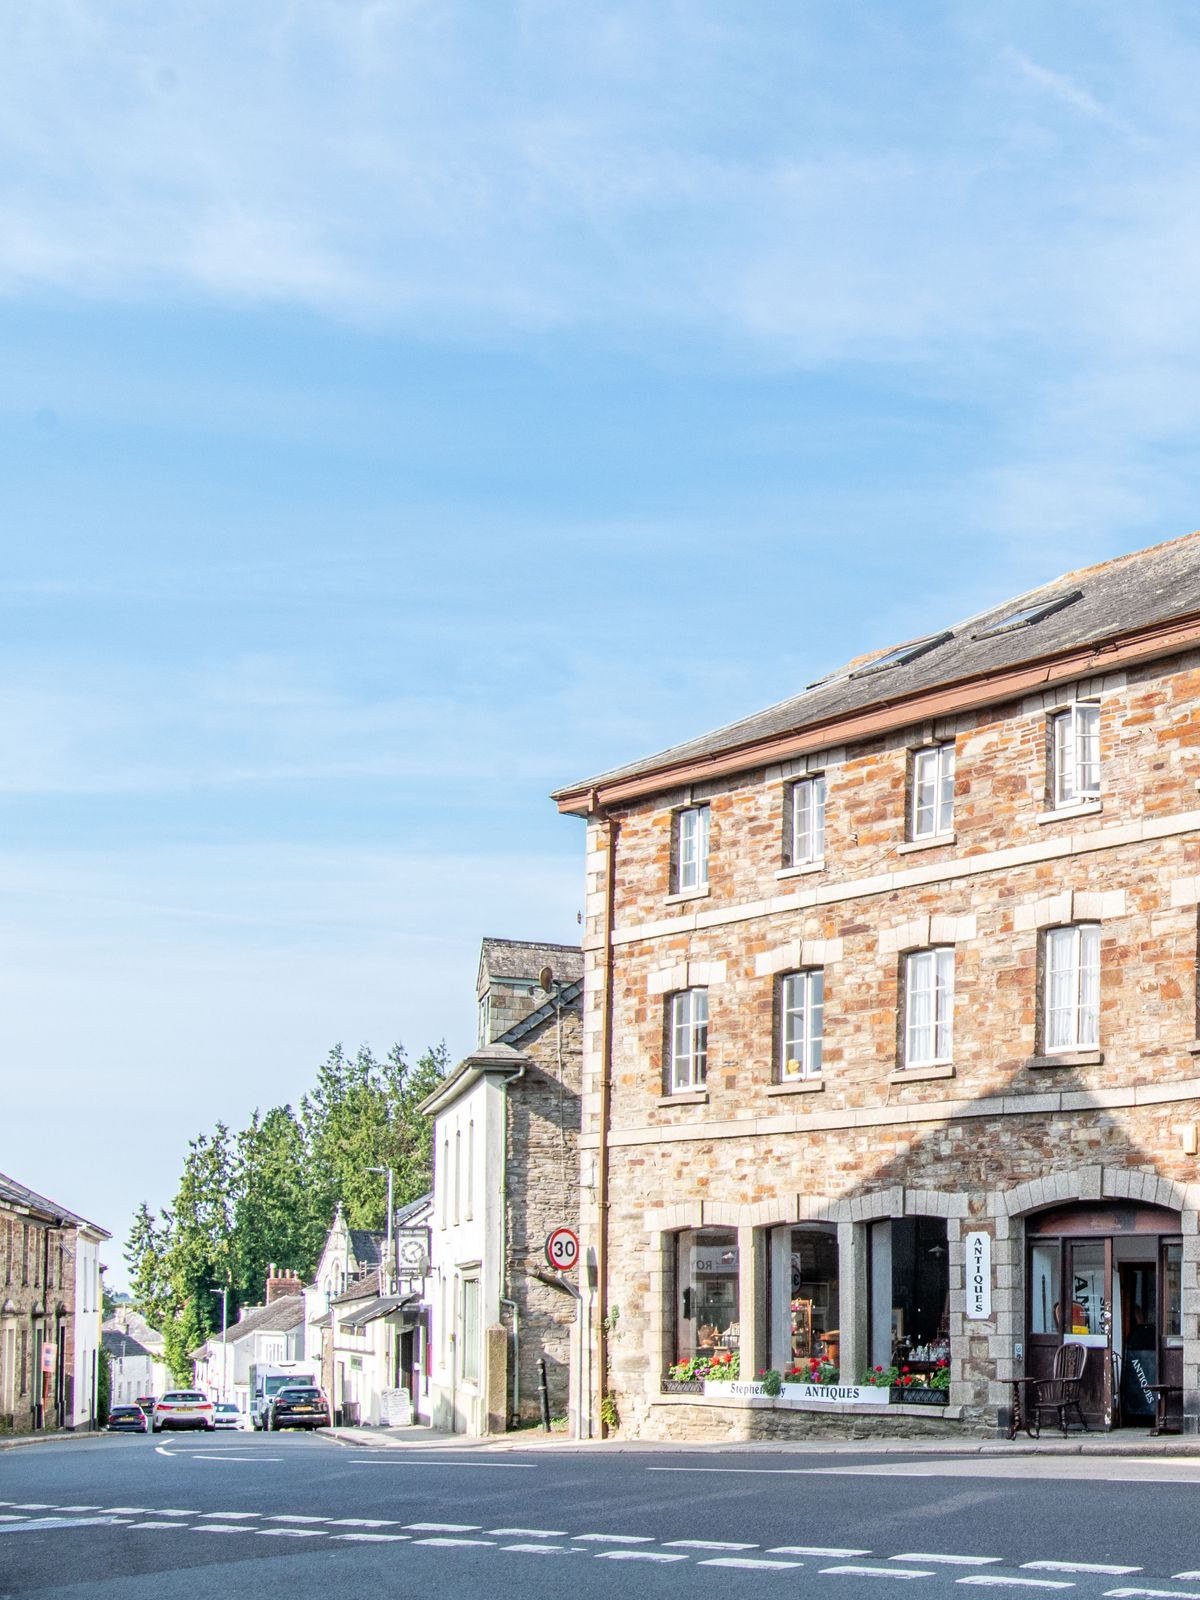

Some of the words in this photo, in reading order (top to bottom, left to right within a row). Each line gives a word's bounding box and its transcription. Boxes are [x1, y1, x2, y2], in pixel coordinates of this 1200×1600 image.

[554, 1241, 575, 1257] 30
[973, 1237, 984, 1313] ANTIQUES
[804, 1386, 860, 1400] ANTIQUES
